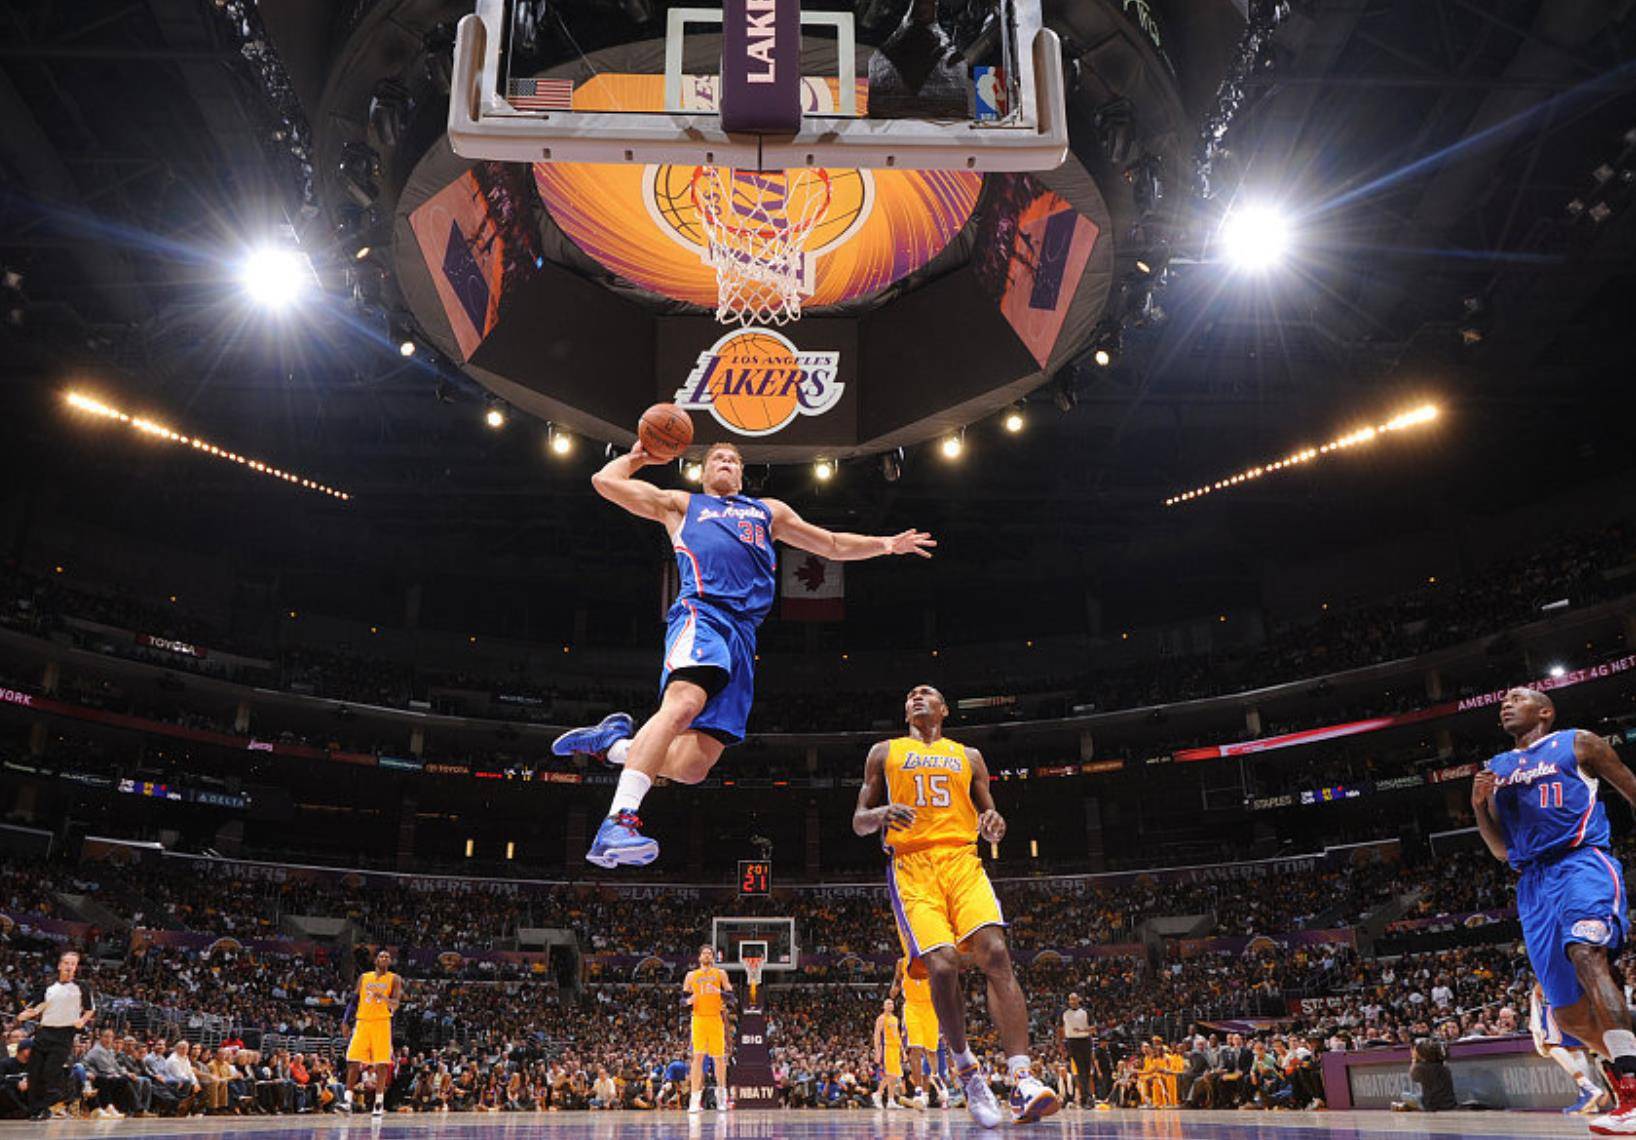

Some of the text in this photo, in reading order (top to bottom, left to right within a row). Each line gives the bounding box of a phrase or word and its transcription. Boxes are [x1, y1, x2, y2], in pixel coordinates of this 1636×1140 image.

[732, 356, 832, 365] LOS ANGELES
[684, 355, 835, 408] LAKERS
[148, 635, 198, 656] TOYOTA
[1592, 665, 1608, 679] 4G
[901, 752, 962, 772] LAKERS
[914, 774, 951, 807] 15
[1539, 781, 1563, 808] 11
[743, 874, 766, 892] 21
[739, 1086, 774, 1100] NBA TV
